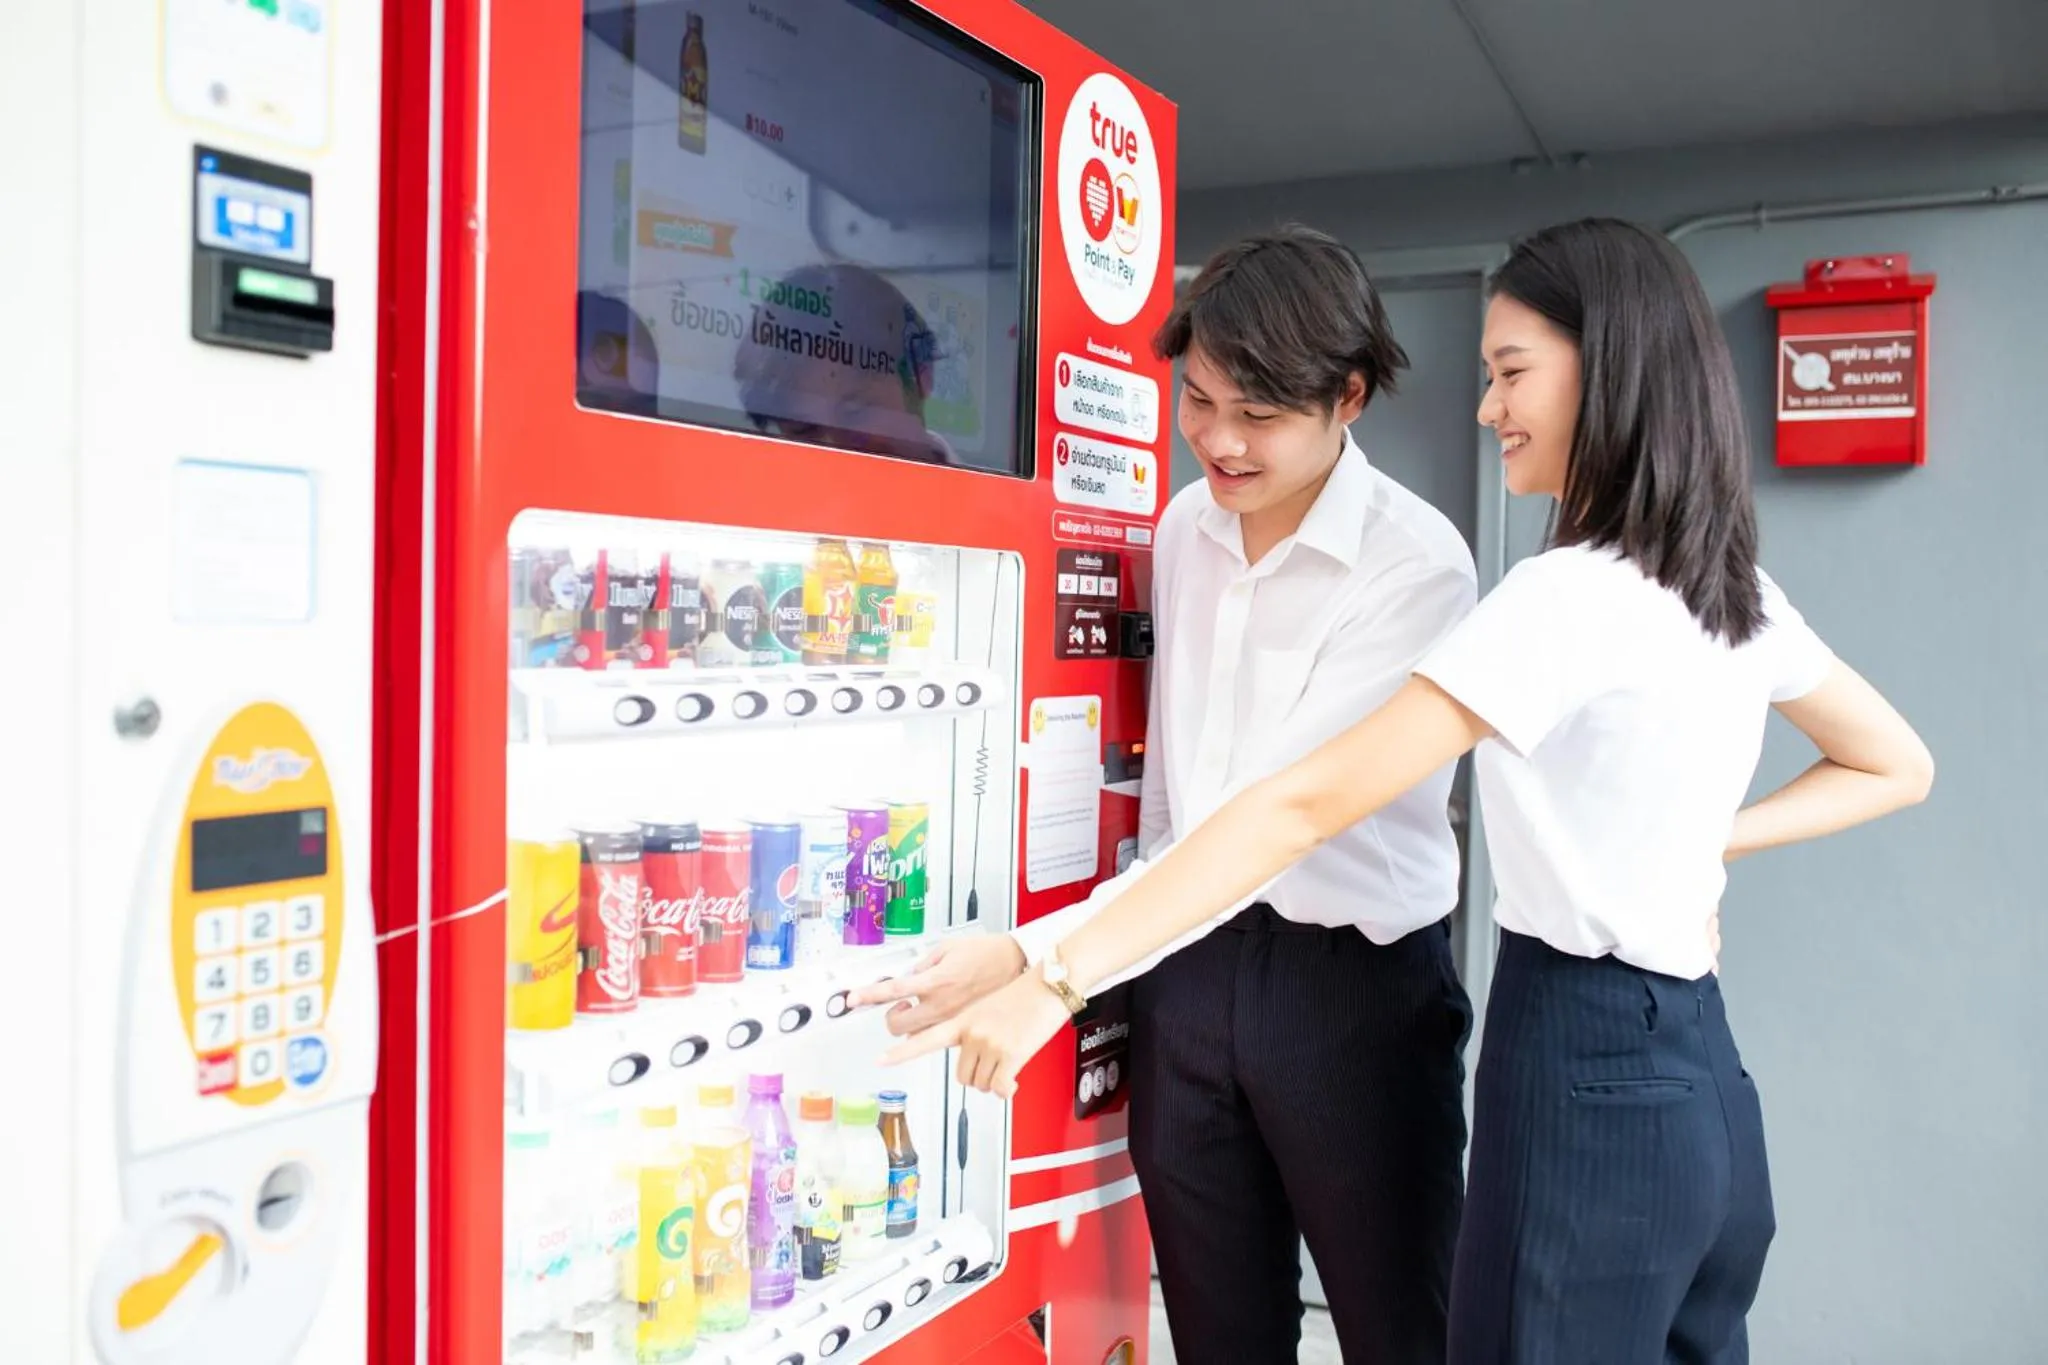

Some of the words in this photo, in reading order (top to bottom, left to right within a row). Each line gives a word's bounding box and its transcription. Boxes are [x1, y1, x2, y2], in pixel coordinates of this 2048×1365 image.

[1089, 101, 1138, 165] true
[1084, 242, 1110, 272] Point
[1117, 257, 1136, 287] Pay
[750, 302, 853, 367] ได้หลายชิ้น
[1061, 364, 1068, 384] 1
[1059, 442, 1066, 462] 2
[211, 917, 222, 947] 1
[252, 911, 272, 939] 2
[295, 905, 312, 932] 3
[206, 966, 226, 989] 4
[251, 957, 270, 985] 5
[294, 950, 311, 977] 6
[252, 1003, 270, 1032] 8
[295, 995, 311, 1022] 9
[208, 1012, 227, 1041] 7
[251, 1049, 272, 1077] 0
